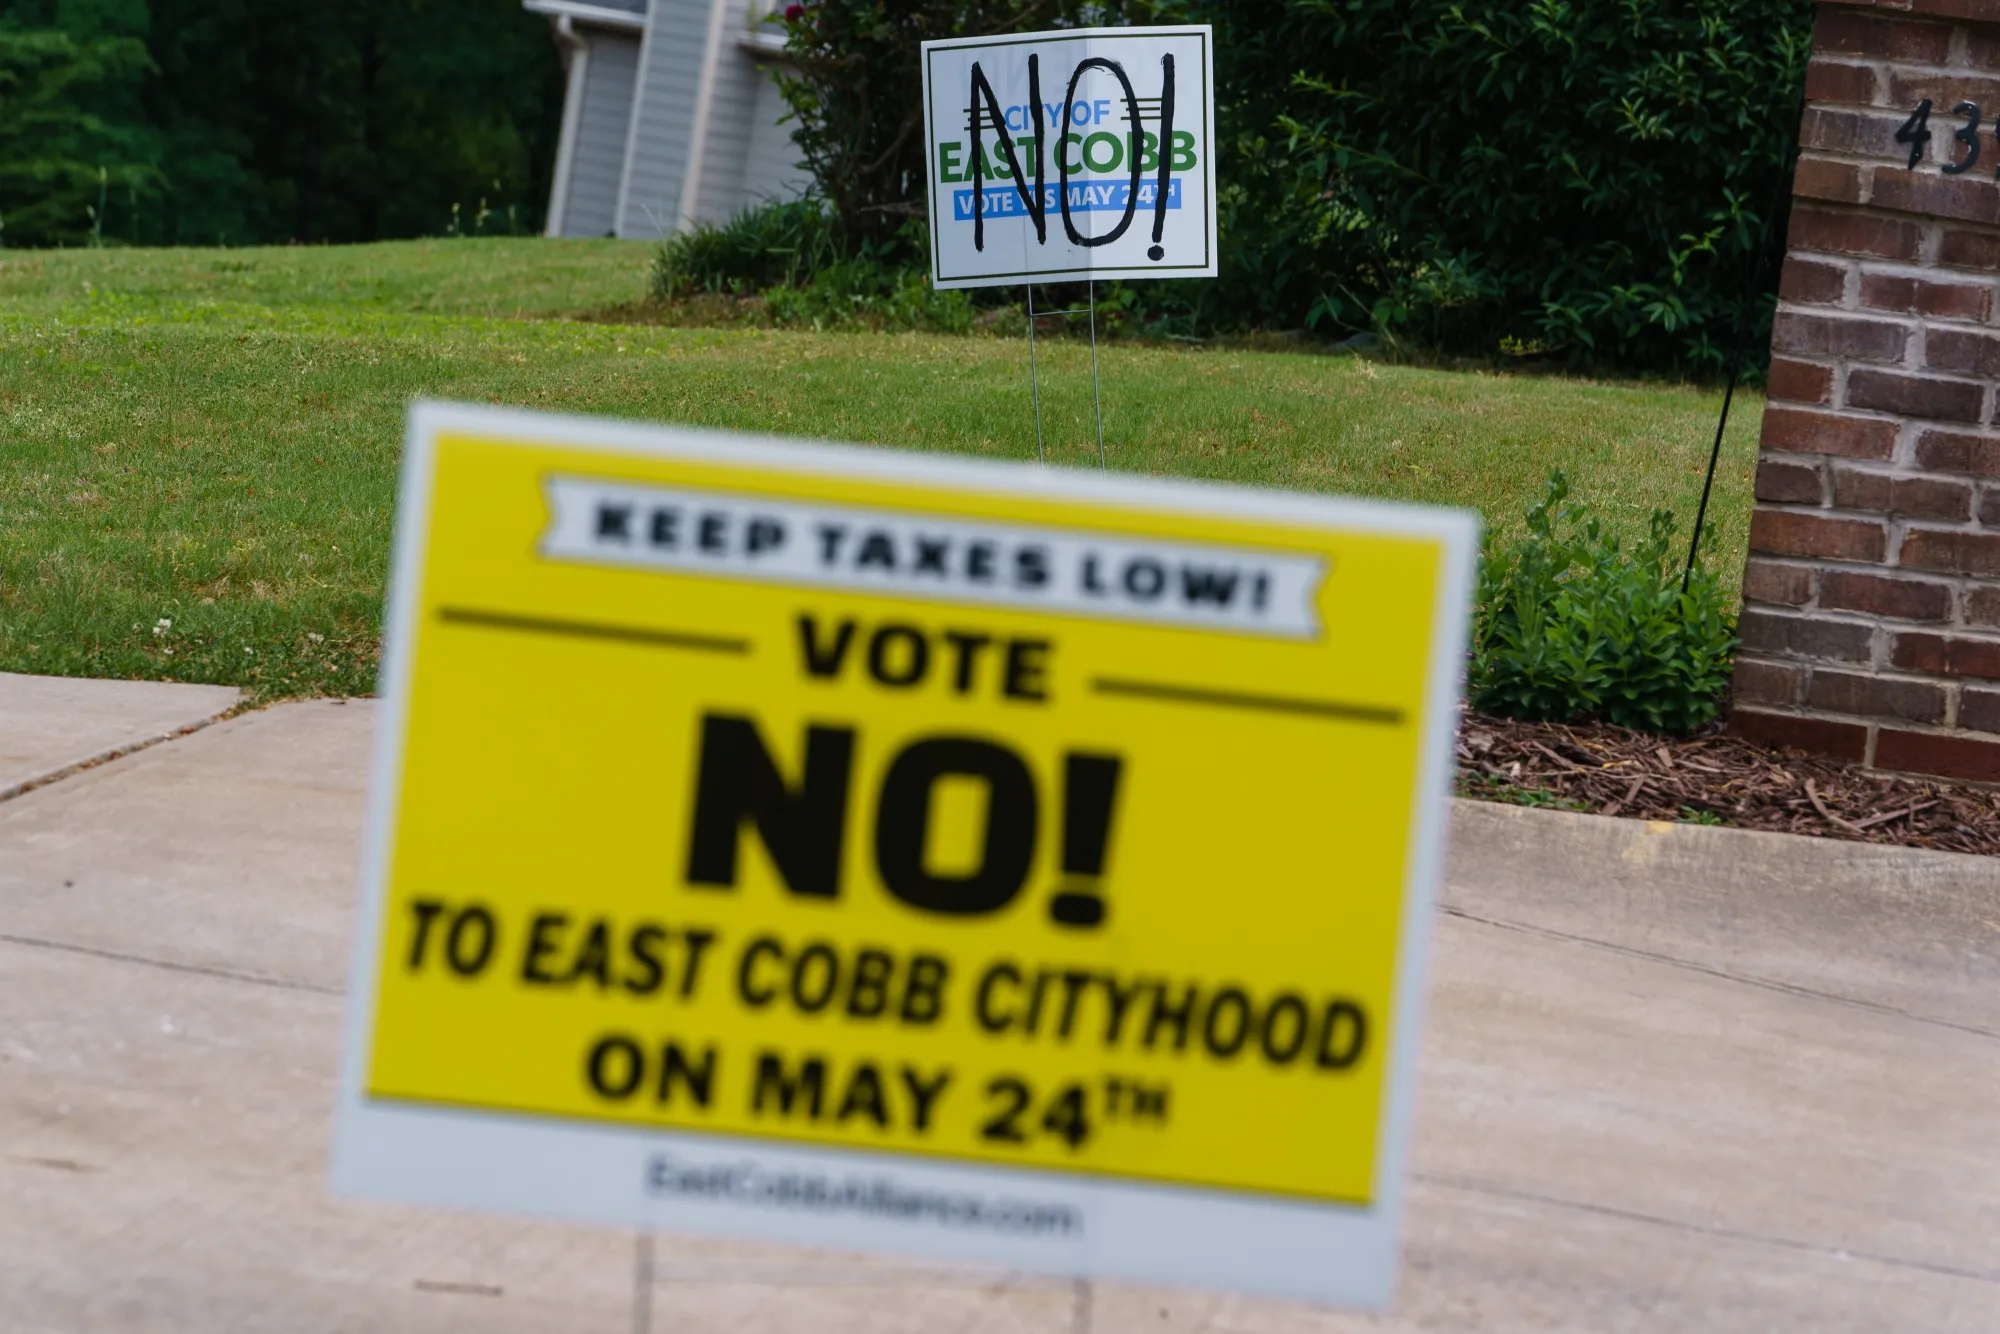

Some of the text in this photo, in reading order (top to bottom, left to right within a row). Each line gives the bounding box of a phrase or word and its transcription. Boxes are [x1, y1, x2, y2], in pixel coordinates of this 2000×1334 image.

[939, 131, 1197, 183] EAST COBB
[971, 52, 1175, 261] NO!
[1004, 100, 1110, 131] CIY OF
[1895, 98, 2000, 180] 43
[958, 193, 1012, 215] VOTE
[1018, 188, 1055, 209] YS
[1067, 184, 1115, 207] MAY
[594, 499, 1271, 612] KEEP TAXES LOW!
[793, 613, 1056, 703] VOTE
[682, 710, 1126, 931] NO!
[406, 900, 1369, 1071] TO EAST COBB CITYHOOD
[584, 1032, 1170, 1152] ON MAY 24TH
